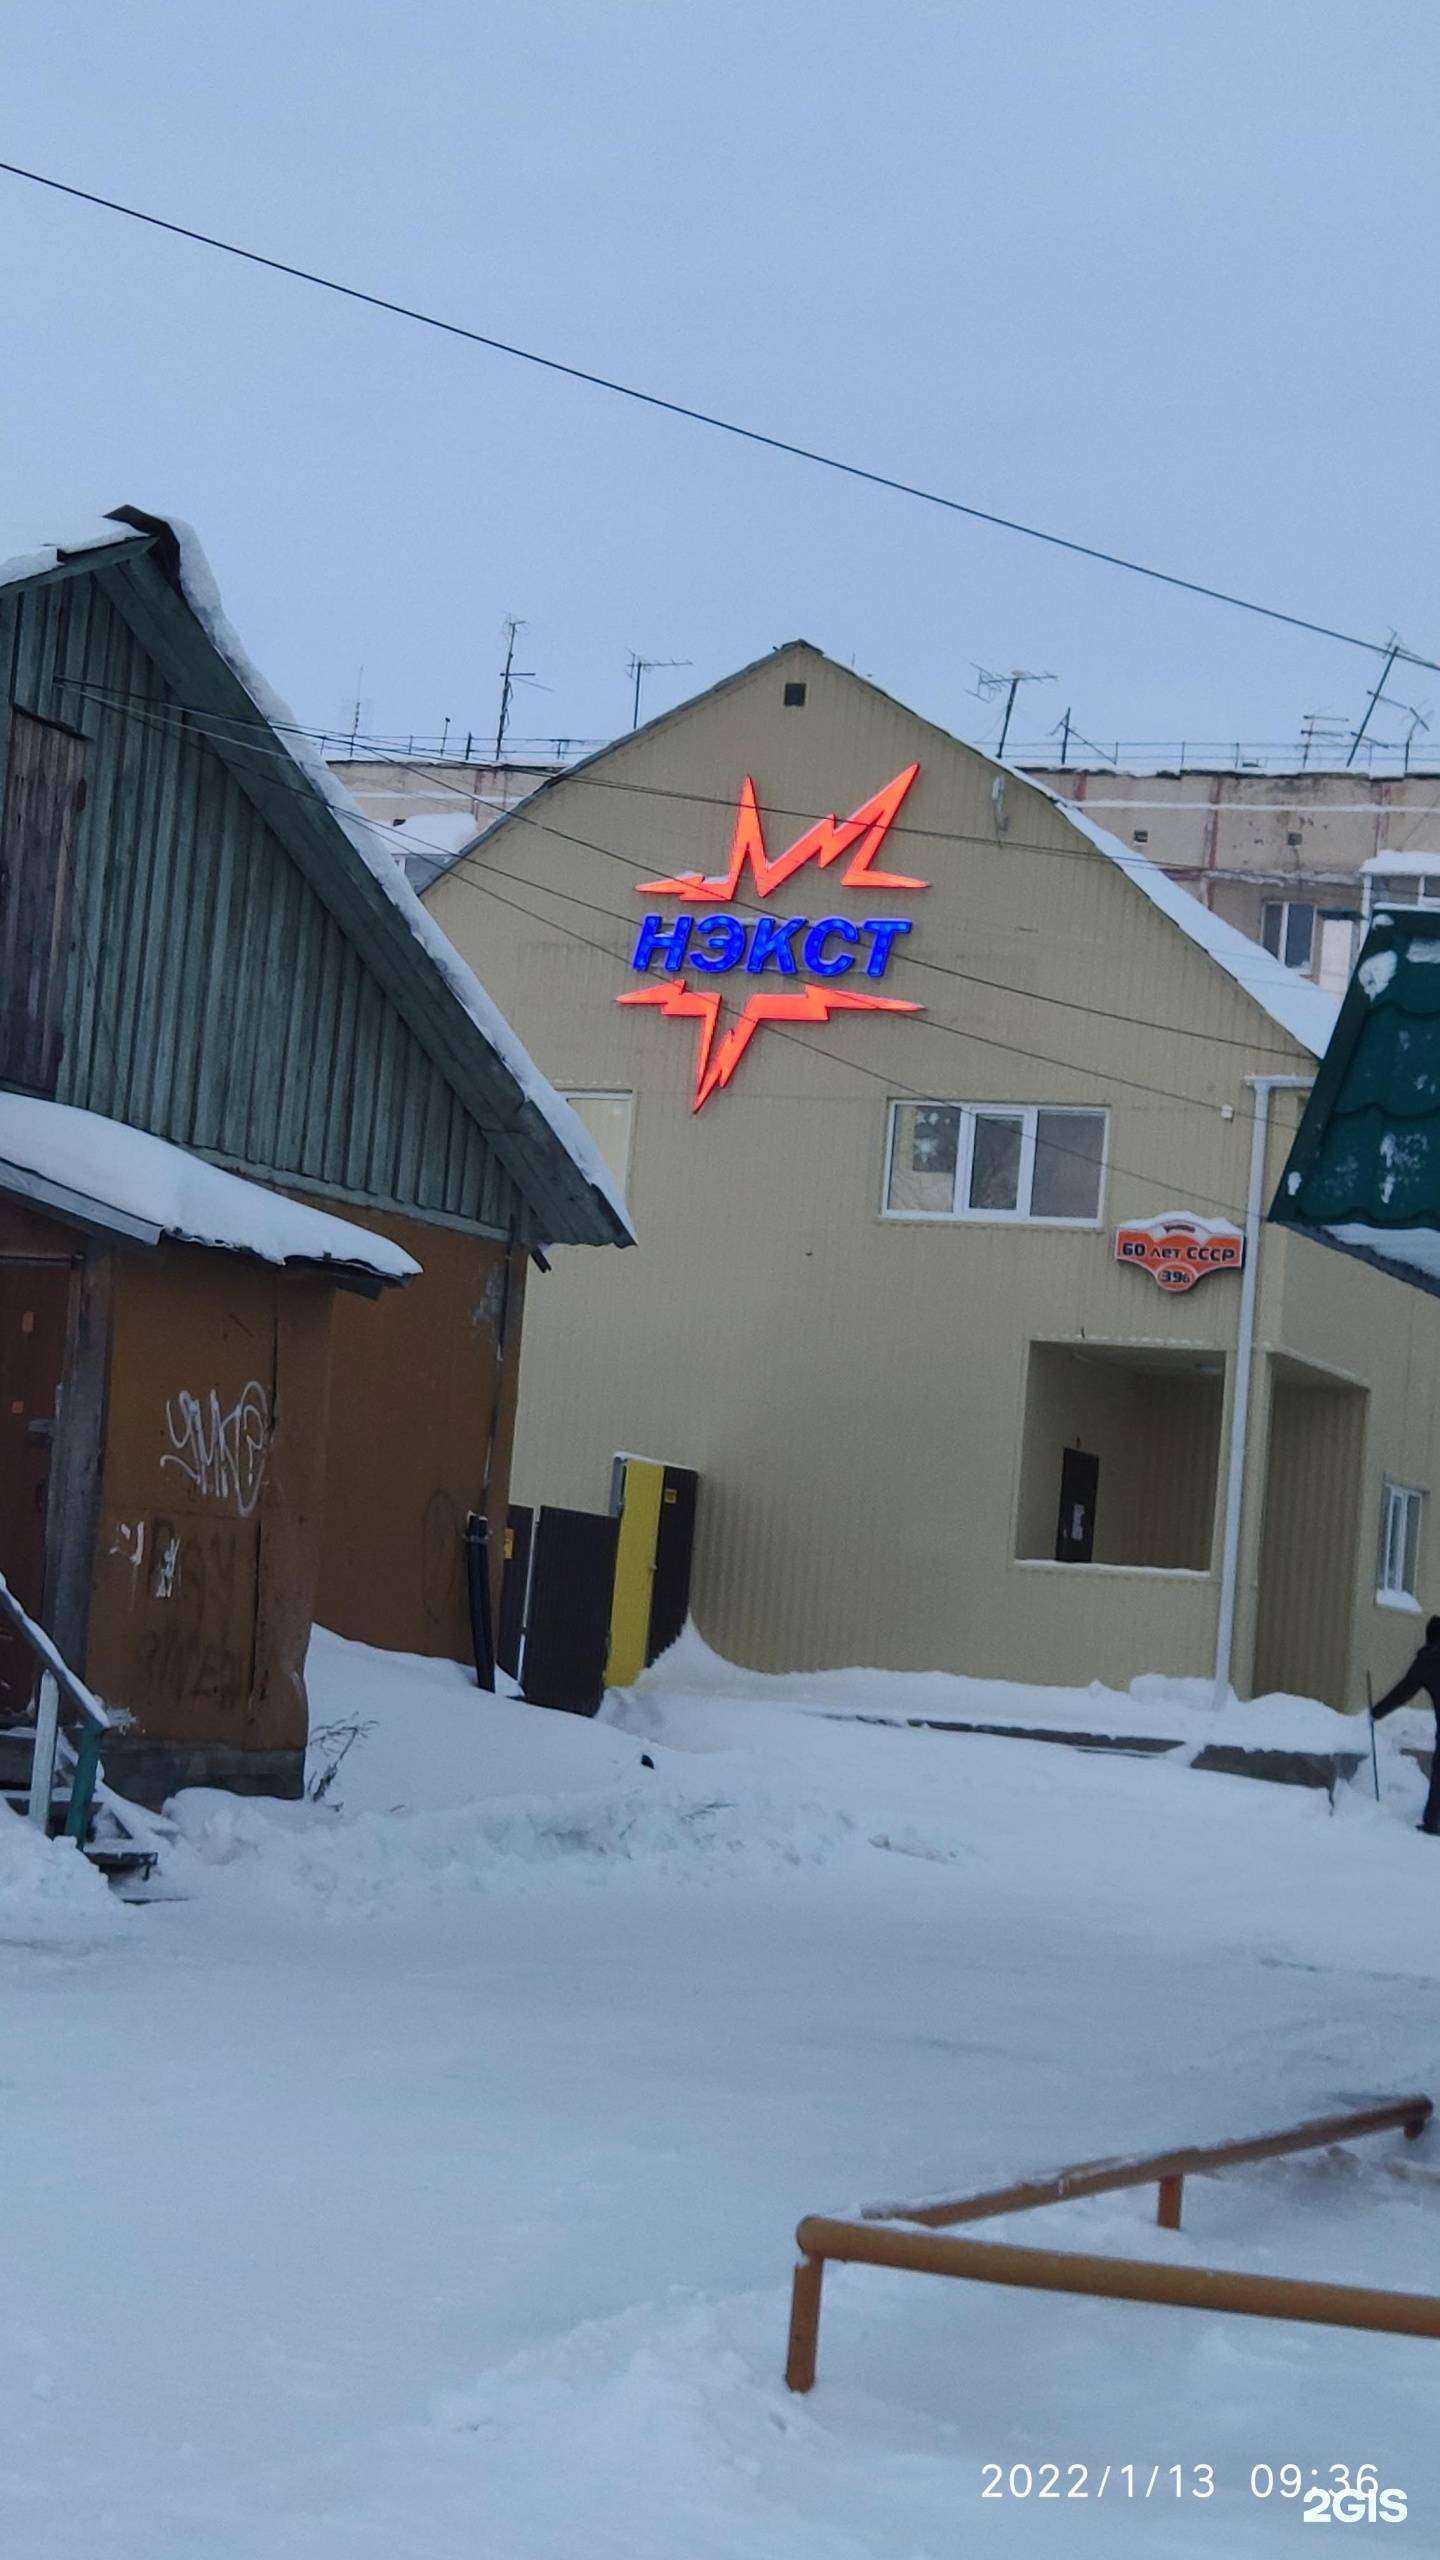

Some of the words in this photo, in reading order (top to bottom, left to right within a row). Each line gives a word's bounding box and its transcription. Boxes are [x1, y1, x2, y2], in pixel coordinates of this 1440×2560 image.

[631, 914, 912, 977] НЭКСТ
[1122, 1242, 1146, 1257] 60
[1187, 1246, 1235, 1262] СССР
